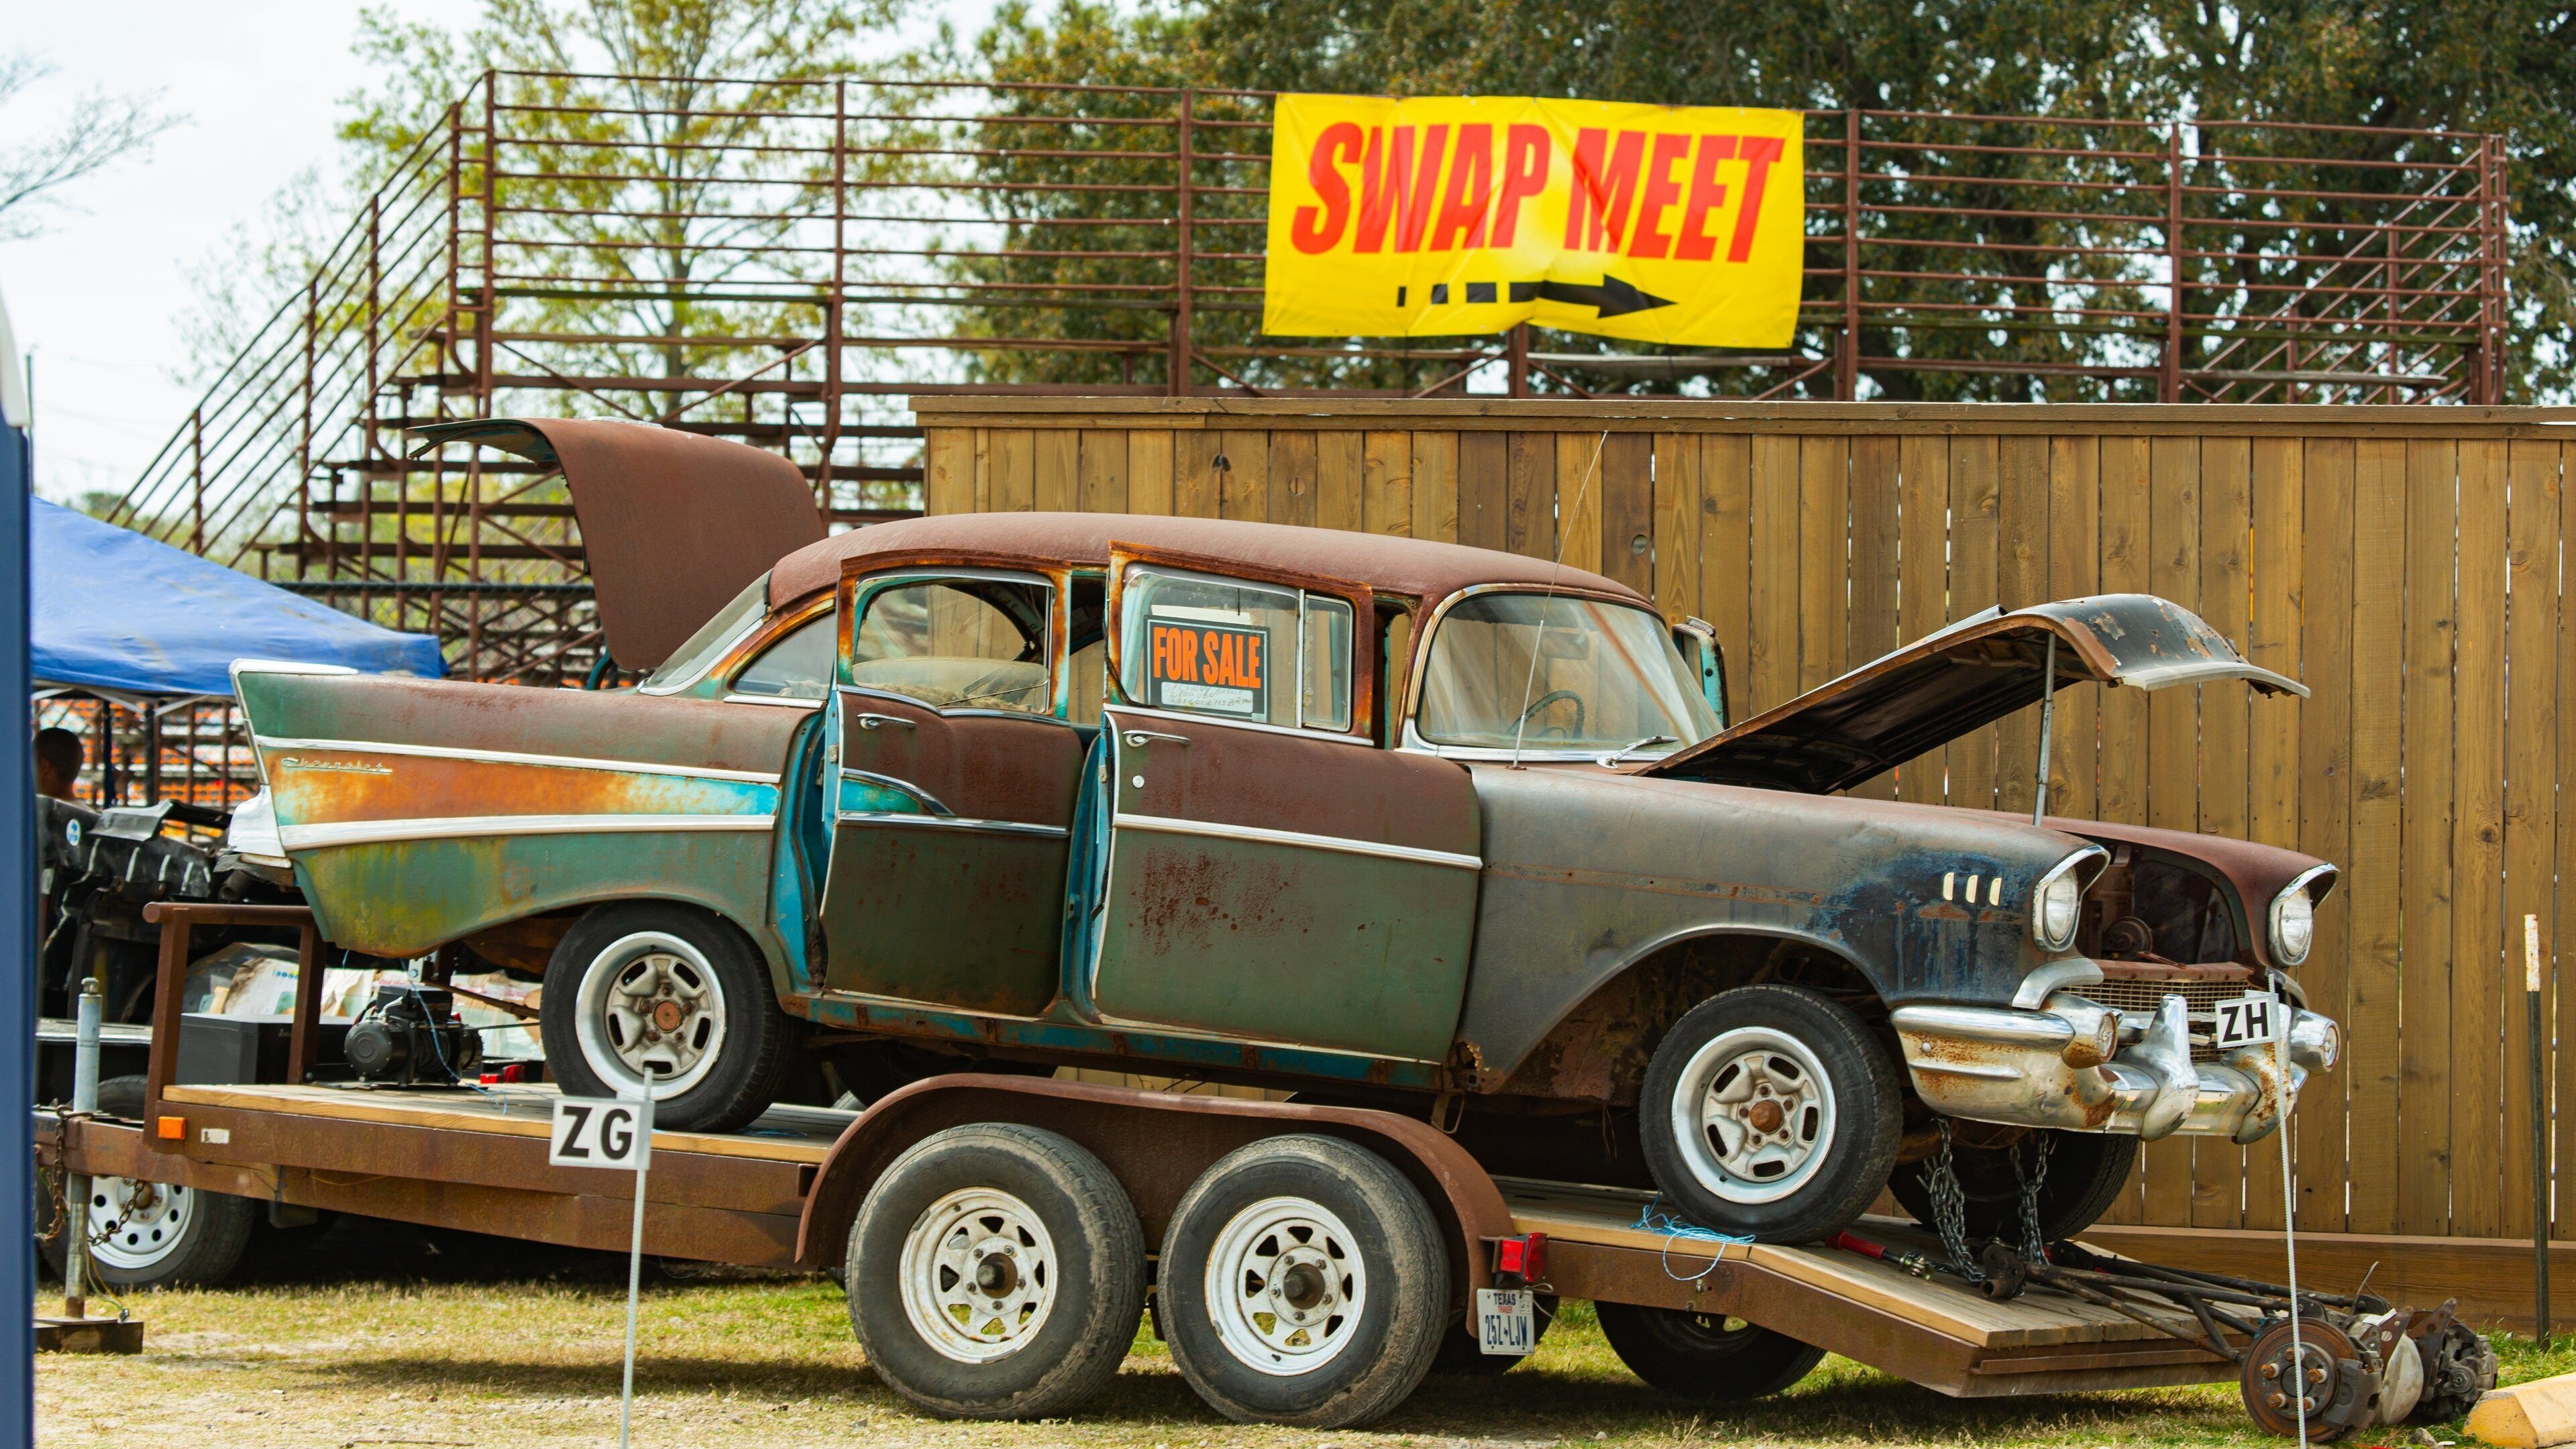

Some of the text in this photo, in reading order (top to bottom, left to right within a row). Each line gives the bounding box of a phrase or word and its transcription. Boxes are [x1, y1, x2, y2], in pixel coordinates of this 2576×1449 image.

[1291, 122, 1784, 262] SWAP MEET
[1153, 627, 1261, 688] FOR SALE
[281, 757, 393, 774] Chevrolet
[2221, 1002, 2269, 1042] ZH
[558, 1106, 633, 1161] ZG
[1493, 1292, 1516, 1305] TEXAS
